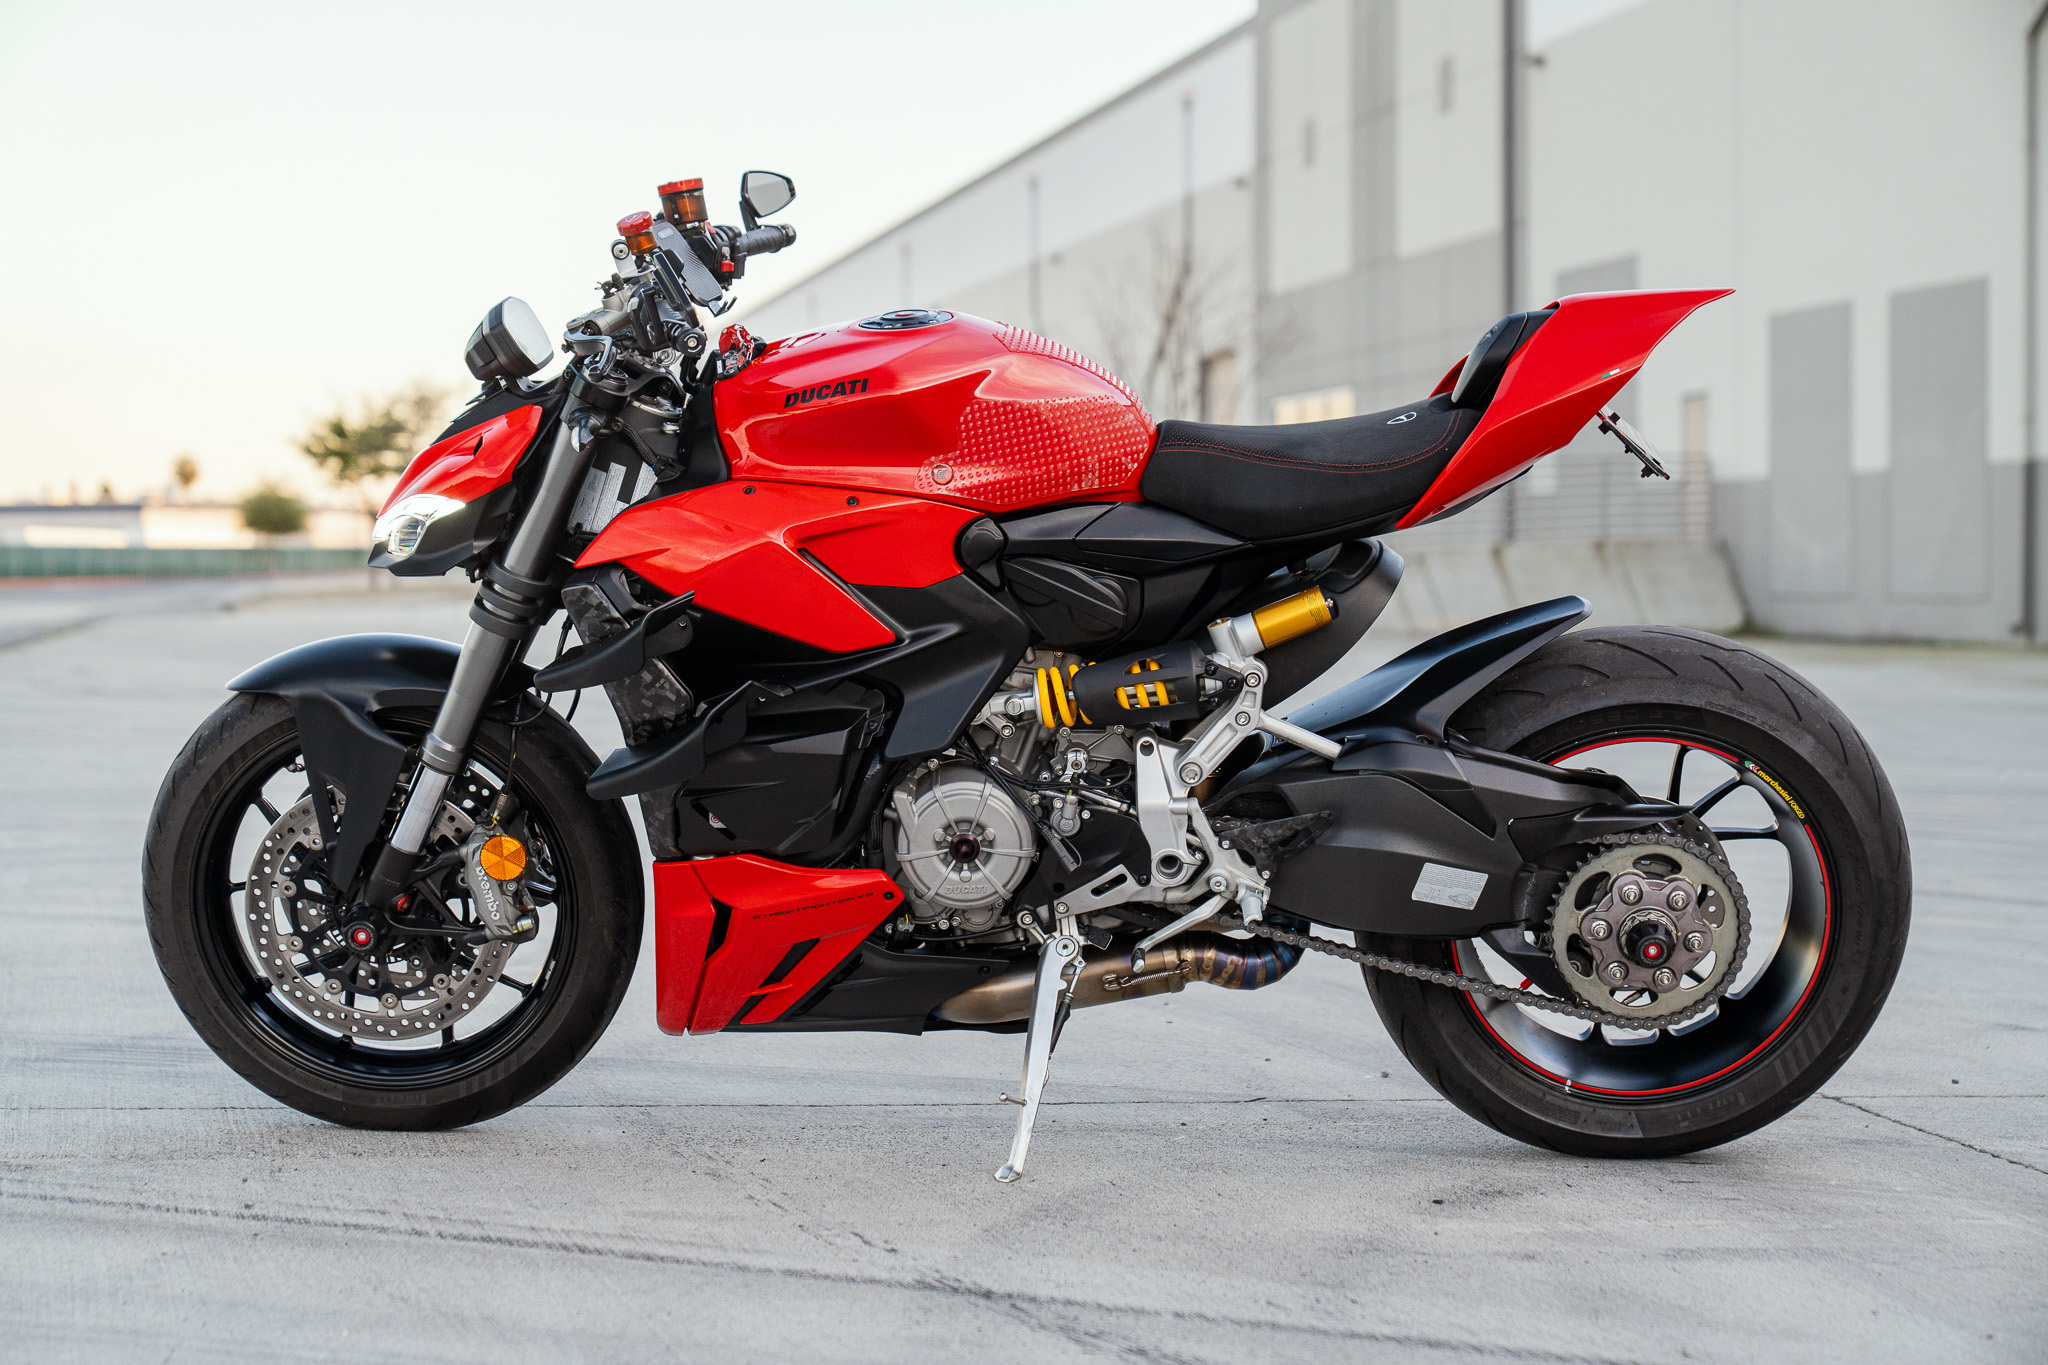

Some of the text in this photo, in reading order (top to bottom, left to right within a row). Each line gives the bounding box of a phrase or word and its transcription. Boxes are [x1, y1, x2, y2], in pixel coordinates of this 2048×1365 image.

[784, 378, 869, 409] DUCATI
[1757, 770, 1805, 819] marchesini FORGED
[475, 866, 500, 920] brembo
[944, 885, 988, 894] DUCATI
[753, 896, 855, 919] STREETFIGHTER
